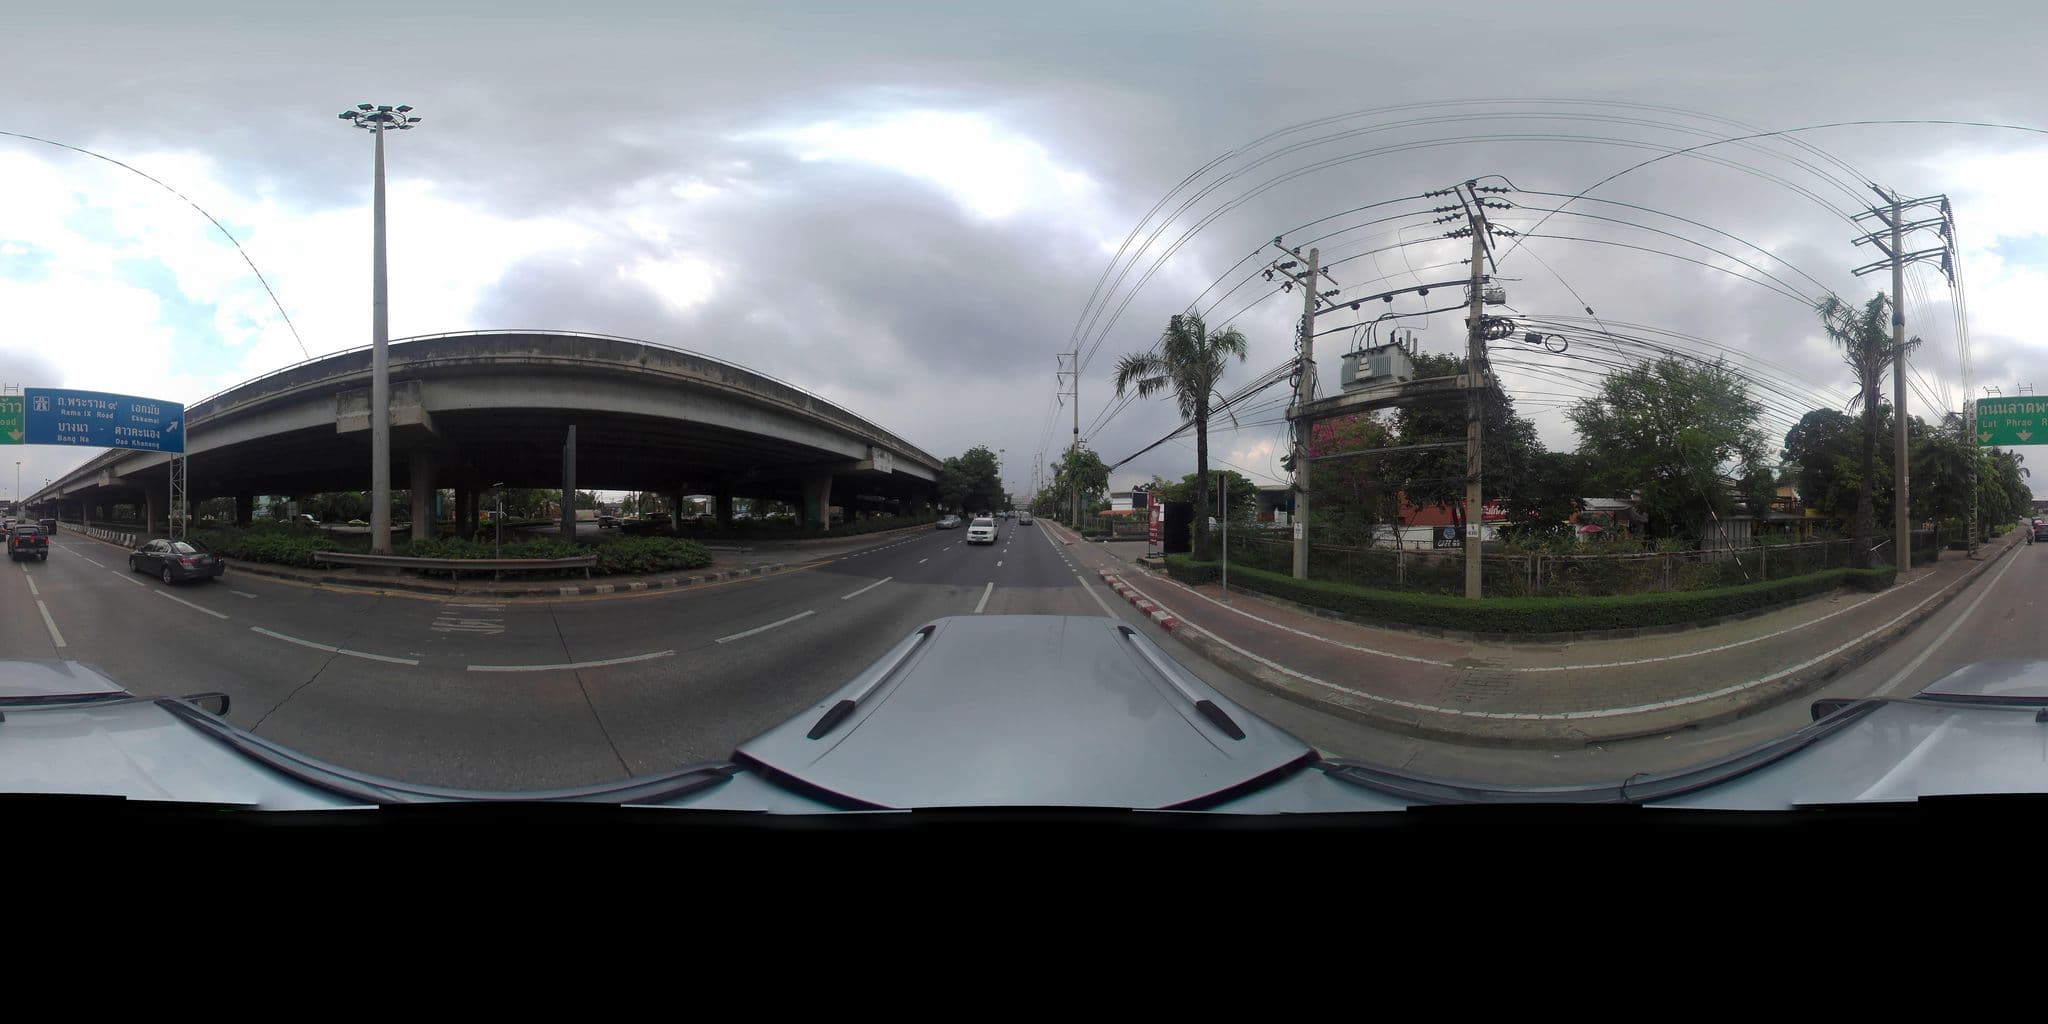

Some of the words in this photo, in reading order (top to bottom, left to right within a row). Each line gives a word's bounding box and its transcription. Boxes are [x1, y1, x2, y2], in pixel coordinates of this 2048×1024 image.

[61, 408, 81, 416] Rama
[97, 411, 114, 419] Road
[131, 404, 160, 416] เอกมัย
[1979, 403, 2048, 415] ถนนลาดพ
[58, 422, 88, 432] บางนา
[1983, 420, 1997, 428] Lat
[2007, 418, 2032, 426] Phrao
[57, 434, 76, 443] Bang
[80, 435, 89, 443] Na
[115, 438, 128, 446] Dao
